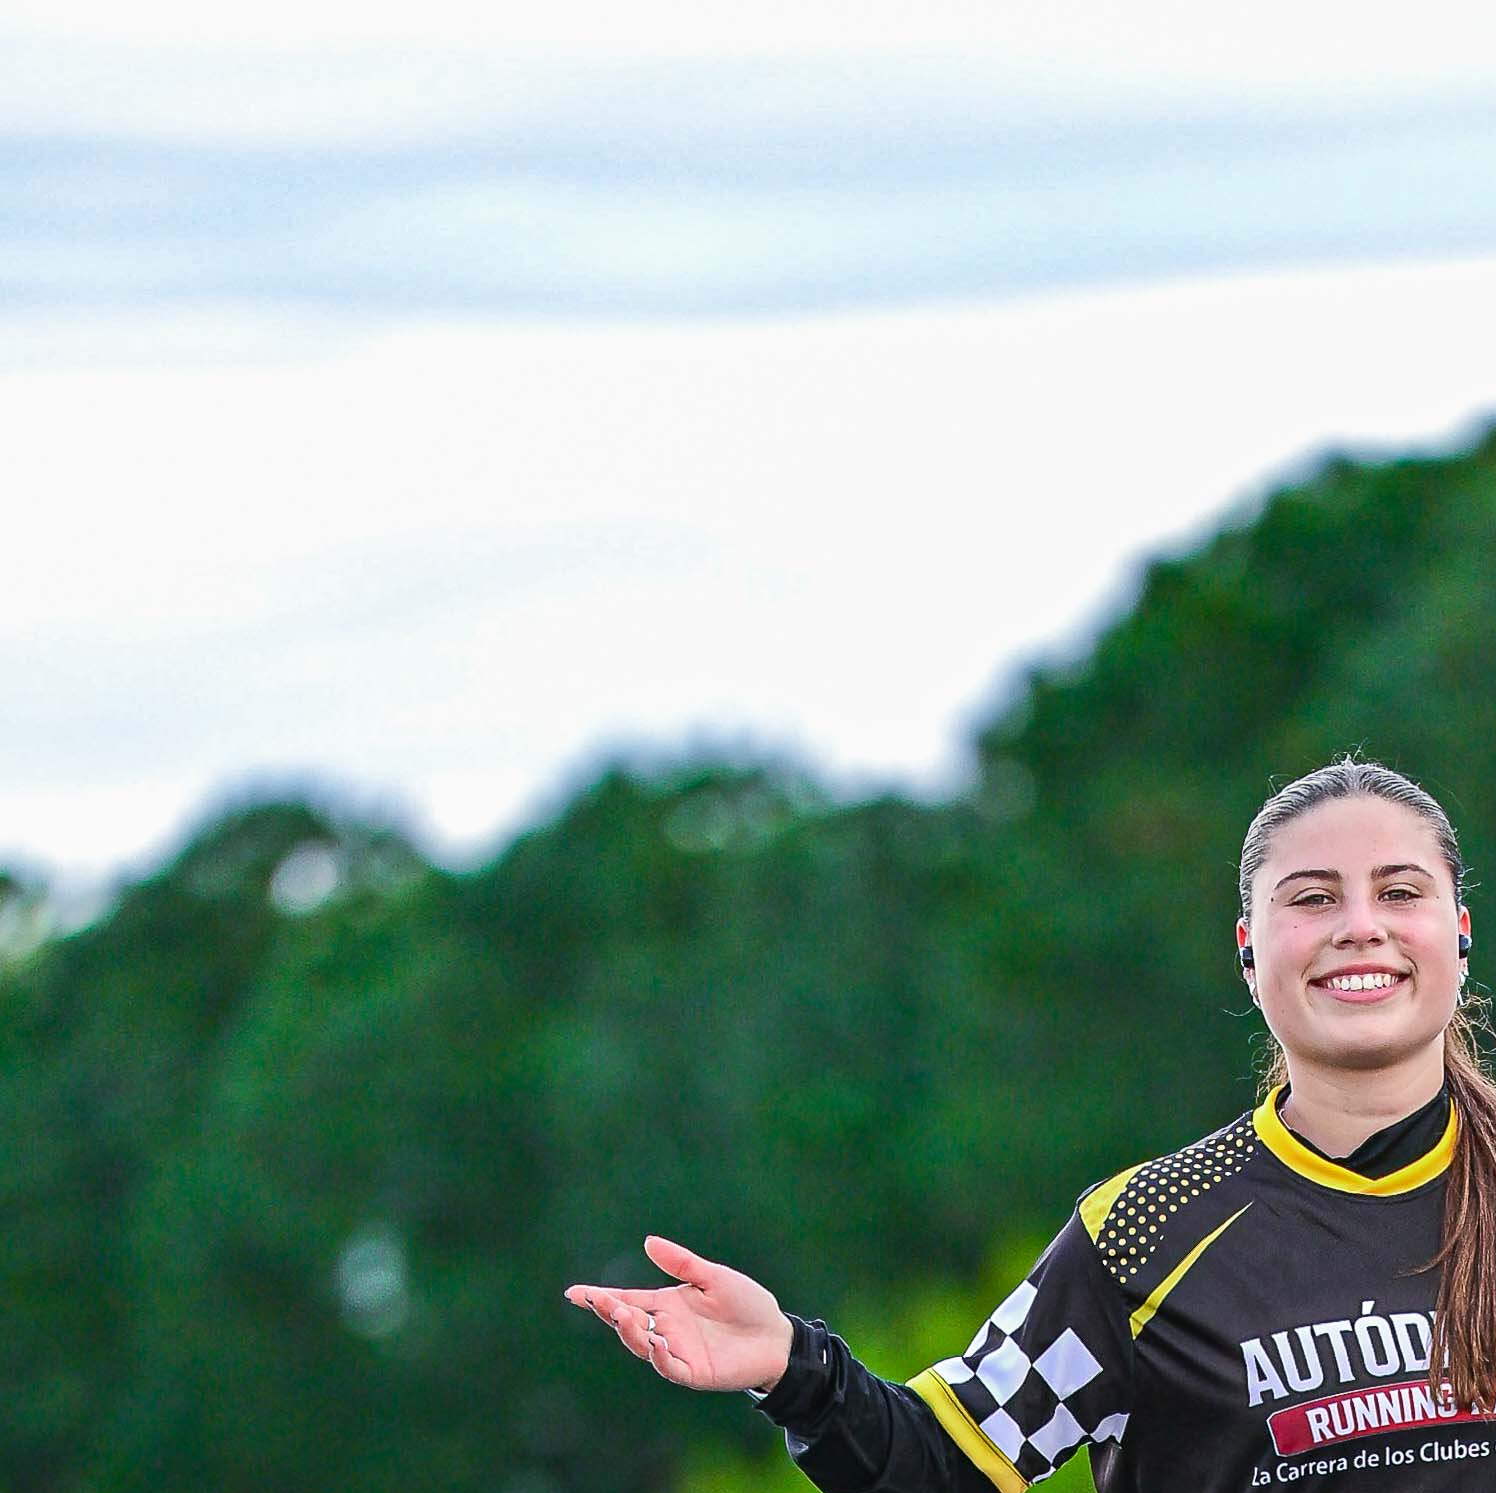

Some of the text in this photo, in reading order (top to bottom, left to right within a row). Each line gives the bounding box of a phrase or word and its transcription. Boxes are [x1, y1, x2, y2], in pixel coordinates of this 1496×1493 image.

[1305, 1382, 1458, 1443] RUNNING
[1251, 1466, 1272, 1487] La
[1276, 1457, 1348, 1483] Carrera
[1353, 1449, 1380, 1469] de
[1385, 1446, 1415, 1466] los
[1420, 1439, 1490, 1463] Clubes
